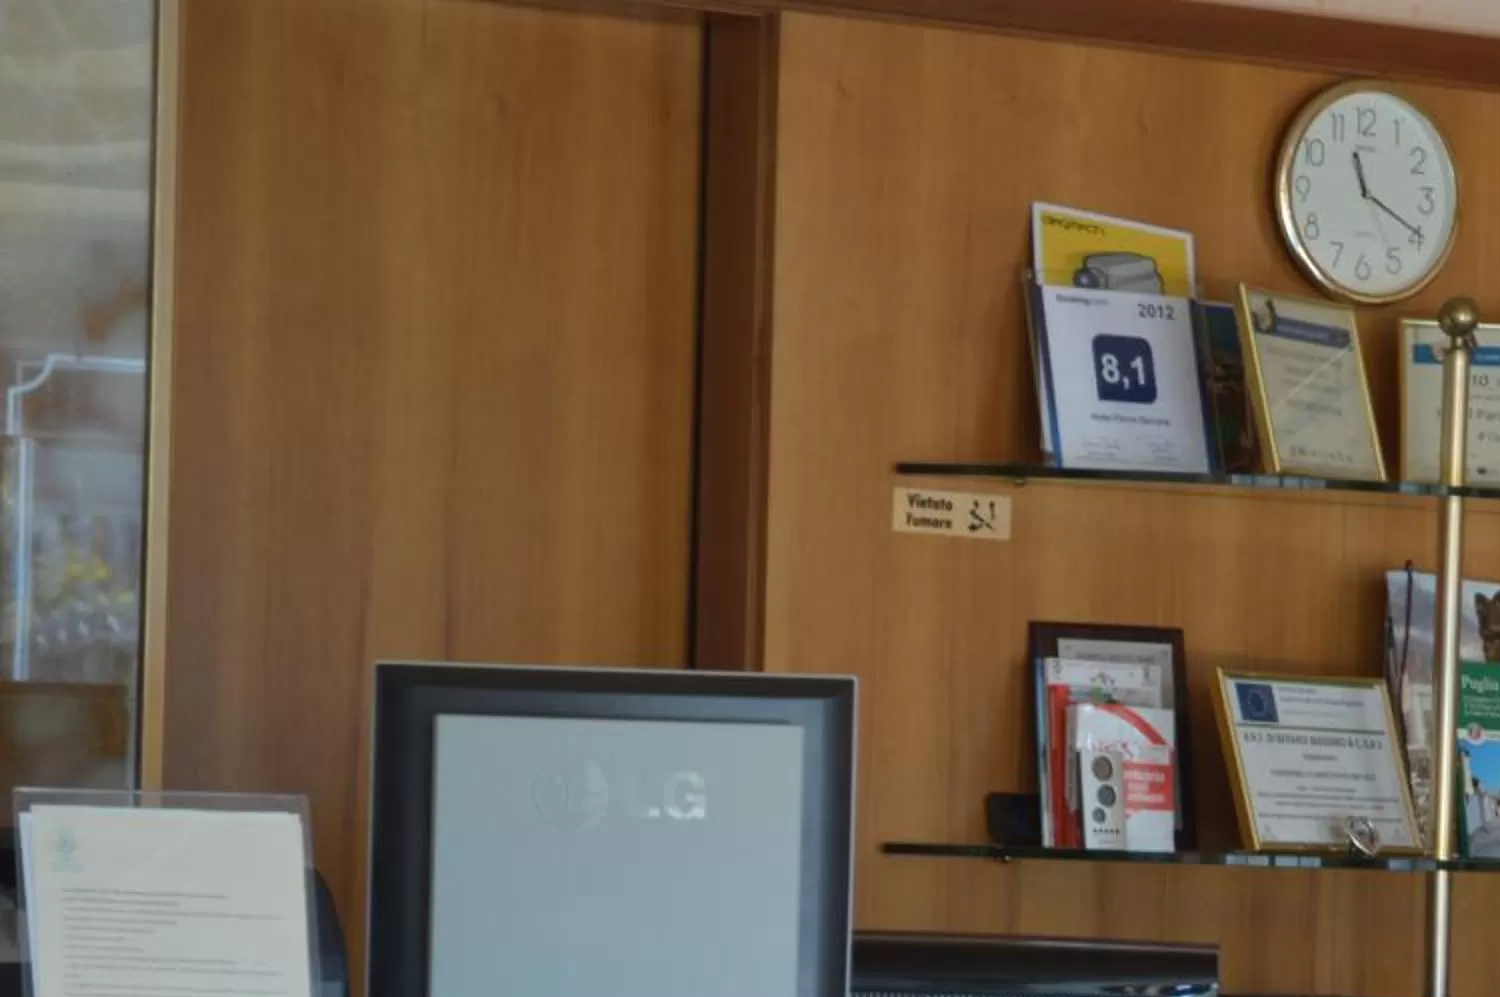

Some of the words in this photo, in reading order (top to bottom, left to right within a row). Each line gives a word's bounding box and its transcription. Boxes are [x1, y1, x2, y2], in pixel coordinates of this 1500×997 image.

[1331, 113, 1345, 143] 11
[1355, 107, 1377, 137] 12
[1392, 119, 1400, 146] 1
[1303, 138, 1325, 167] 10
[1409, 147, 1427, 175] 2
[1296, 176, 1312, 203] 9
[1417, 186, 1435, 216] 3
[1304, 211, 1320, 241] 8
[1408, 225, 1425, 255] 4
[1329, 241, 1345, 269] 7
[1354, 254, 1372, 281] 6
[1386, 247, 1402, 275] 5
[1137, 303, 1176, 321] 2012
[1100, 352, 1148, 391] 8,1
[907, 493, 953, 511] Vietato
[906, 512, 953, 529] Fumare
